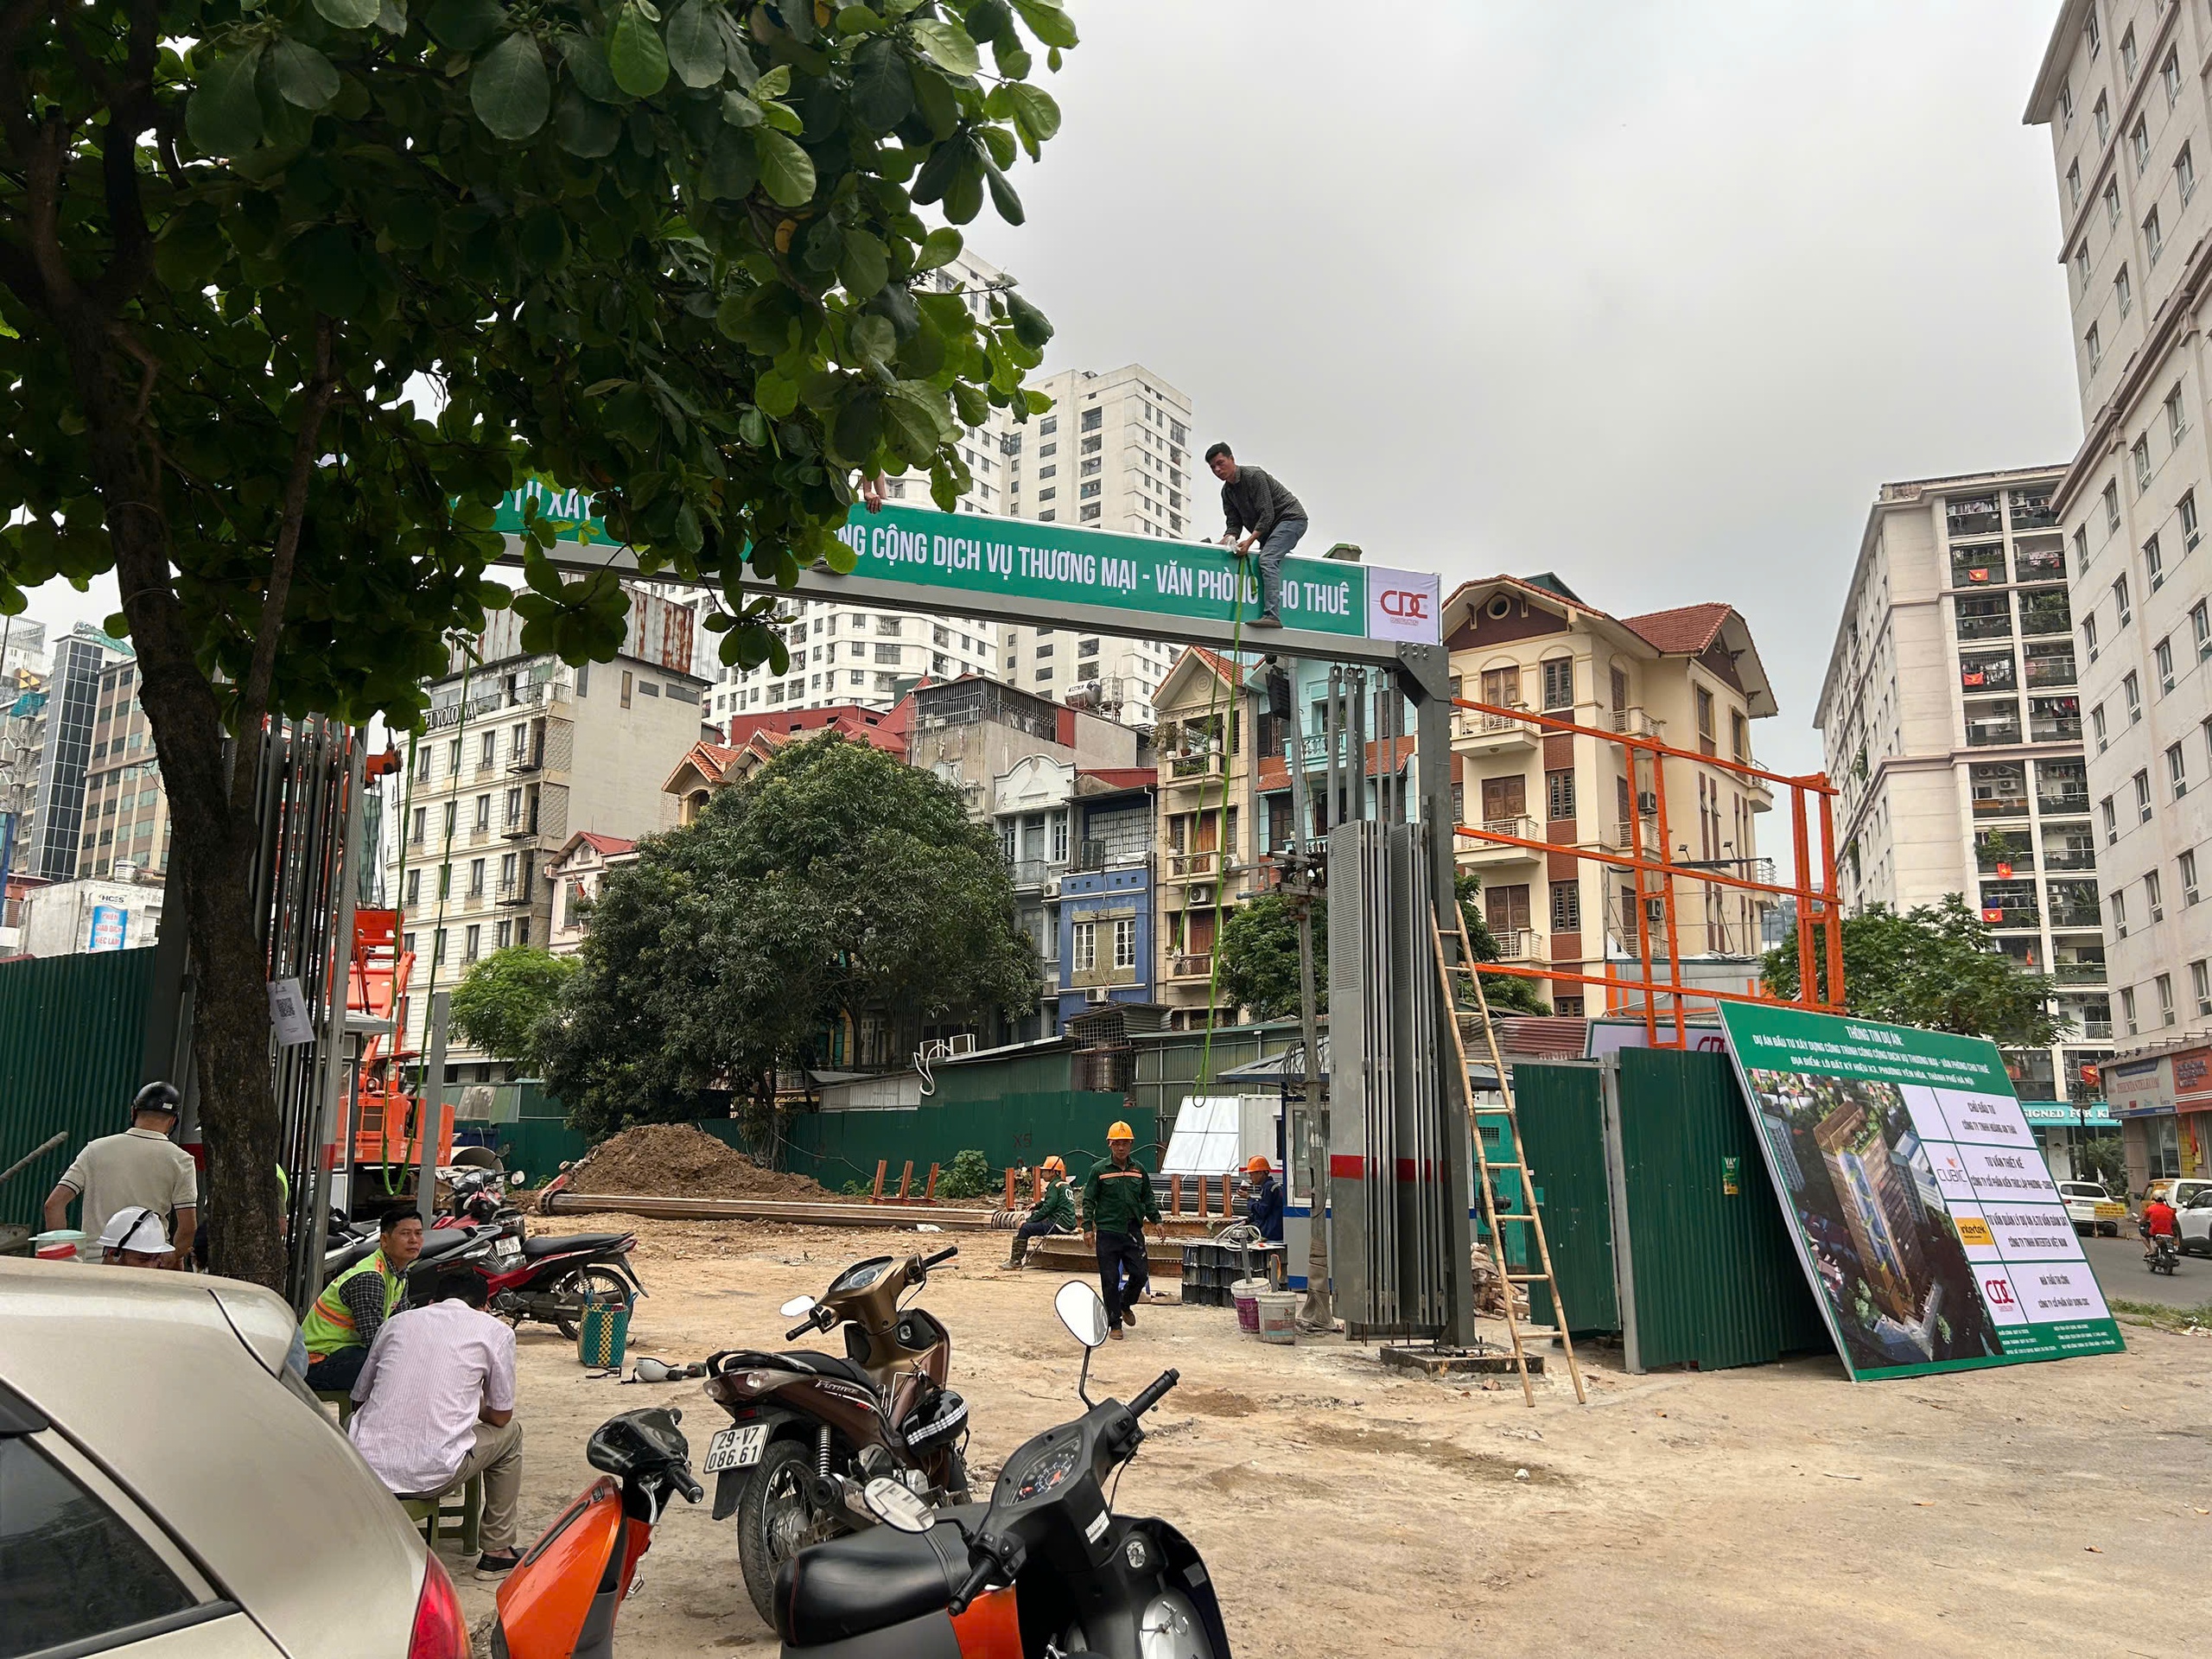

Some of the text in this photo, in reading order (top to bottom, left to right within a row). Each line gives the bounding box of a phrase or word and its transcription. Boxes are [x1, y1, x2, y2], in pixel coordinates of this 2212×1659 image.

[872, 524, 927, 566] CỘNG
[933, 535, 980, 574] DỊCH
[986, 542, 1013, 581] VỤ
[1018, 546, 1096, 585] THƯƠNG
[1101, 556, 1137, 594] MẠI
[1155, 560, 1192, 597] VĂN
[1303, 581, 1351, 616] THUÊ
[1380, 590, 1427, 619] CDC
[1846, 1026, 1870, 1040] THÔNG
[1868, 1029, 1882, 1042] TIN
[2069, 1109, 2092, 1118] FOR
[1937, 1169, 1967, 1182] CUBIC
[1961, 1224, 1986, 1234] intertek
[1986, 1280, 2013, 1304] CDC
[717, 1427, 760, 1450] 29-V7
[708, 1445, 758, 1470] 086.61
